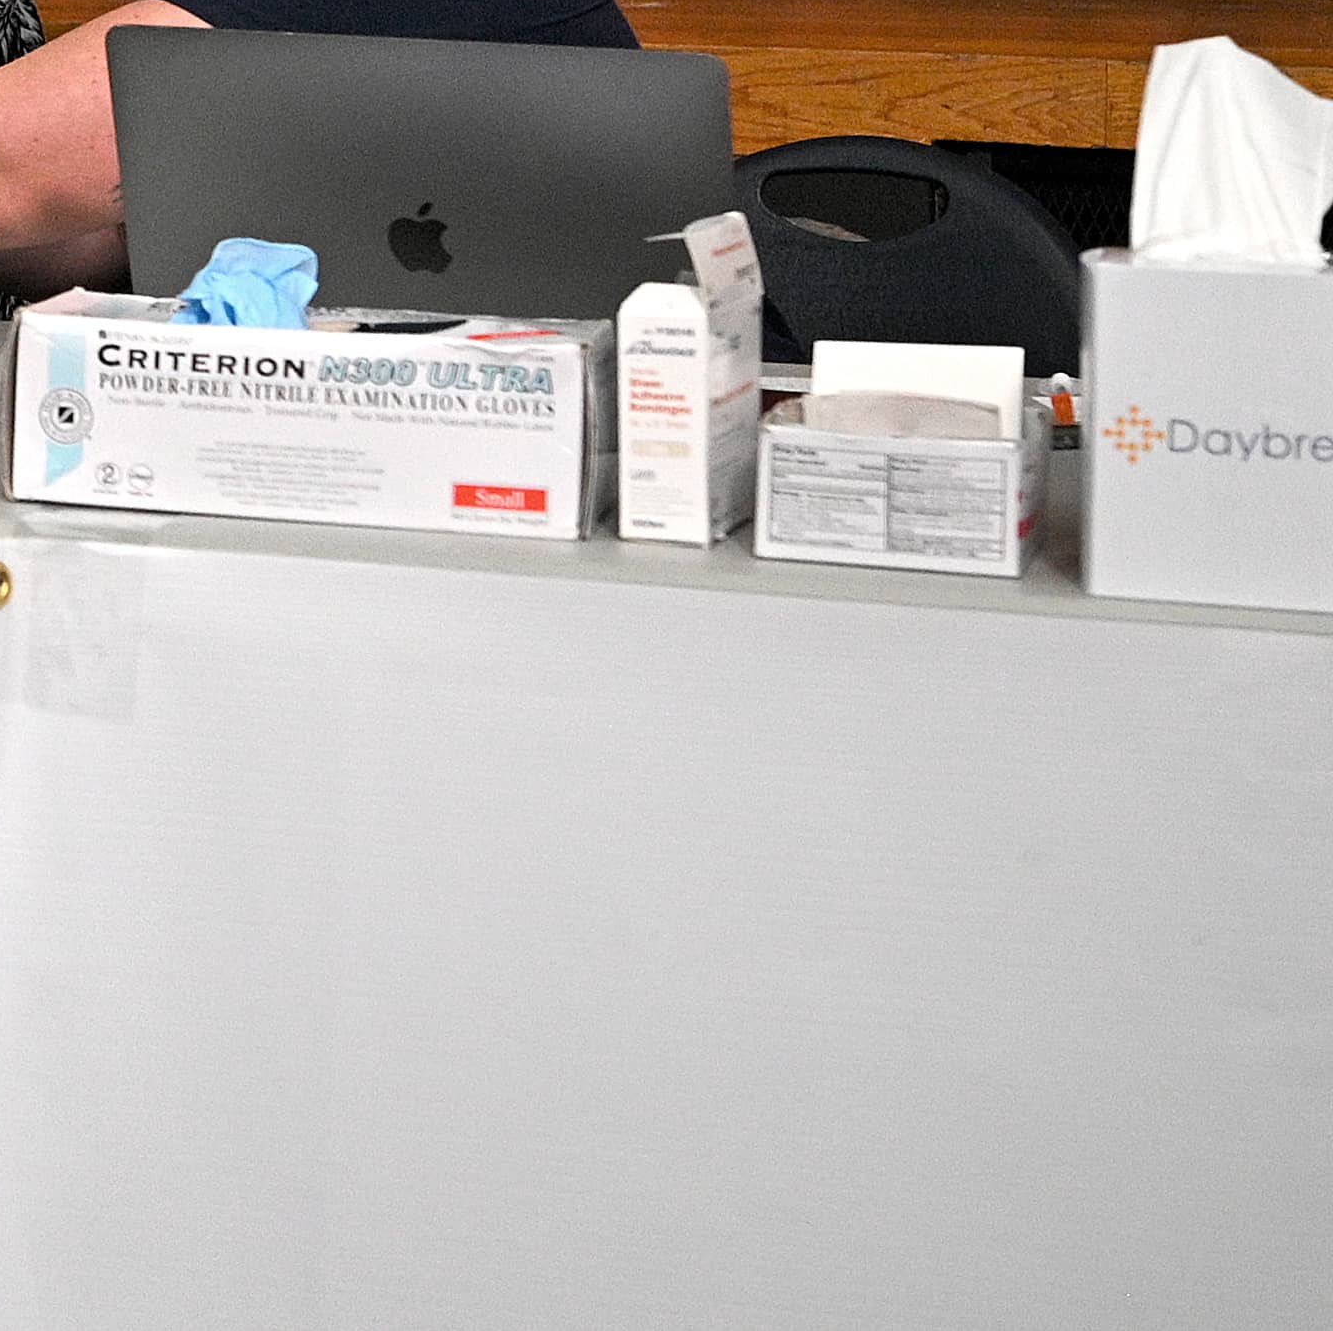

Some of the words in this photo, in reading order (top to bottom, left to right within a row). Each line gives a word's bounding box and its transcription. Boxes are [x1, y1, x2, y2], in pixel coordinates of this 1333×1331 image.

[97, 343, 306, 380] CRITERION
[319, 355, 418, 387] N300
[427, 360, 555, 395] ULTRA
[98, 372, 233, 399] POWDER-FREE
[240, 382, 320, 403] NITRILE
[323, 387, 469, 412] EXAMINATION
[475, 395, 557, 418] GLOVES
[474, 489, 526, 510] Small
